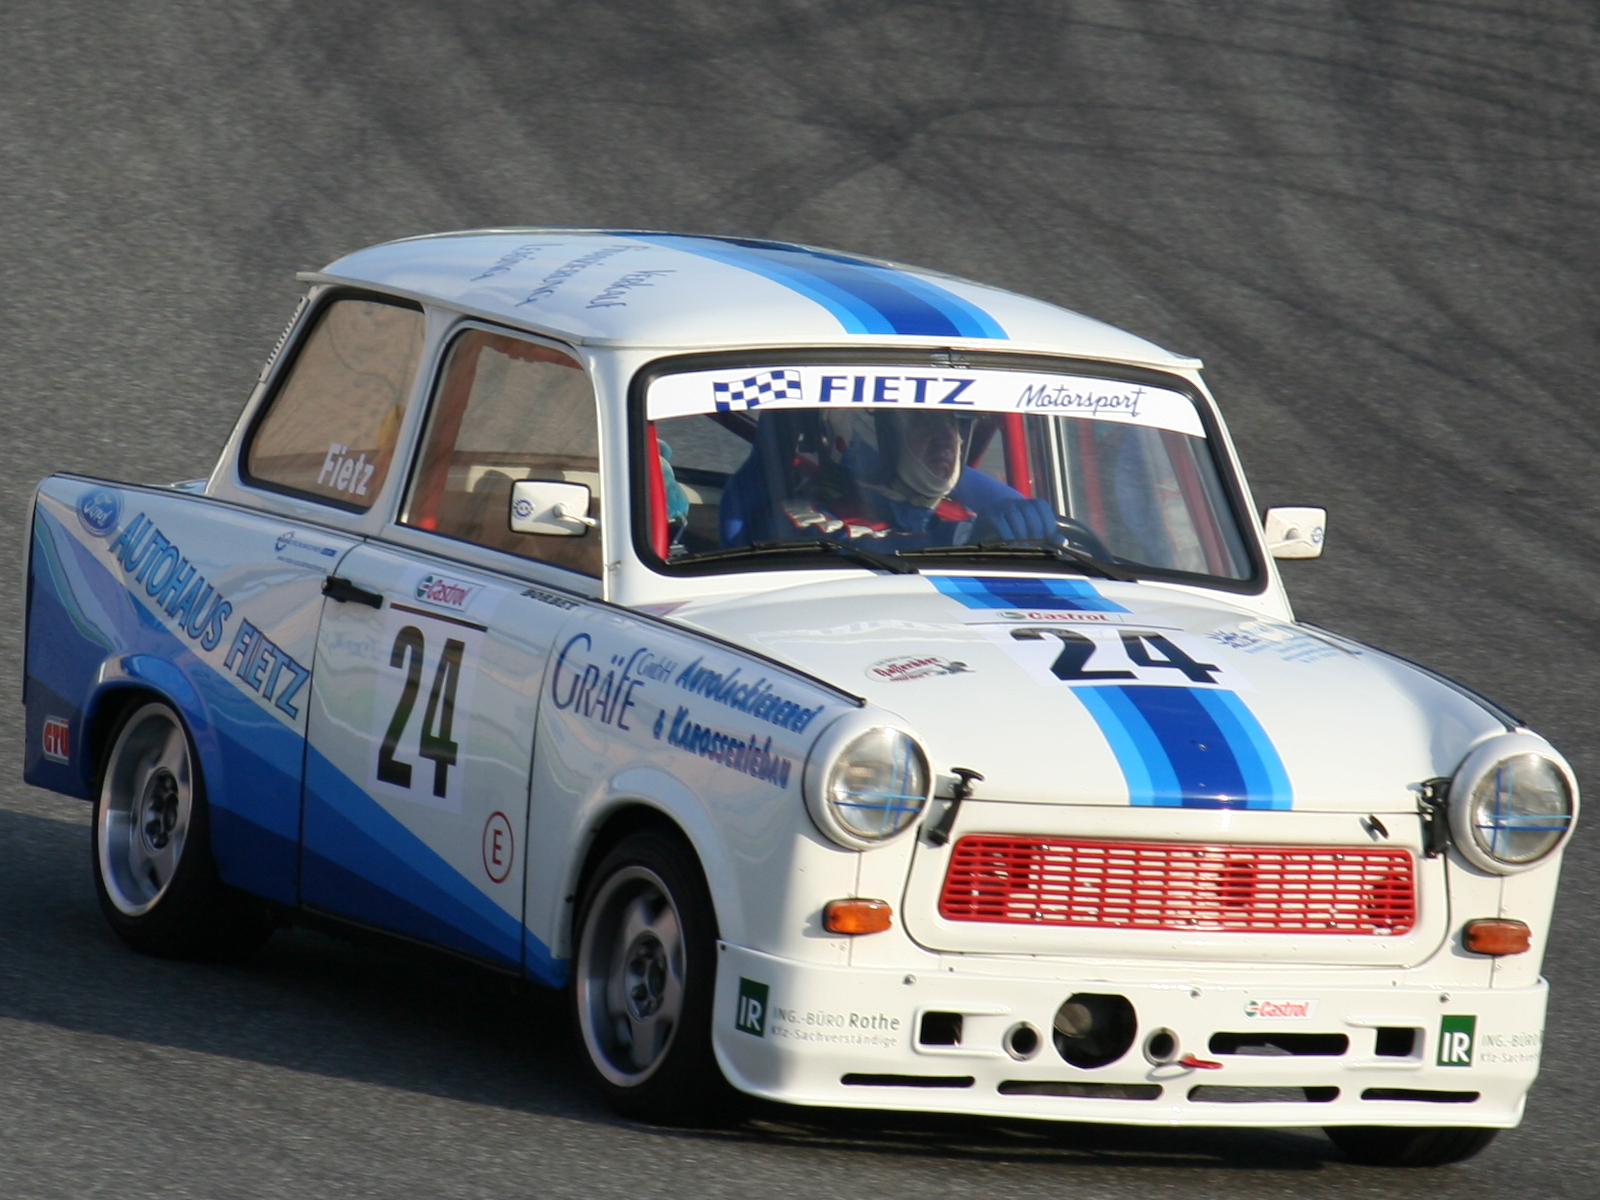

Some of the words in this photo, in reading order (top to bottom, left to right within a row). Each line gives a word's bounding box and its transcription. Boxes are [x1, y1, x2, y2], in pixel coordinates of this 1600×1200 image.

[818, 375, 977, 405] FIETZ
[1015, 383, 1147, 417] Motorsport
[317, 443, 375, 496] Fietz
[427, 579, 473, 606] Castrol
[109, 512, 232, 652] AUTOHAUS
[224, 617, 311, 720] FIETZ
[1027, 611, 1109, 622] Castrol
[1010, 627, 1223, 685] 24
[377, 625, 466, 799] 24
[491, 828, 503, 866] E
[738, 996, 762, 1032] IR
[850, 1011, 901, 1032] Rothe
[1258, 1001, 1309, 1018] Castrol
[1441, 1031, 1470, 1063] IR
